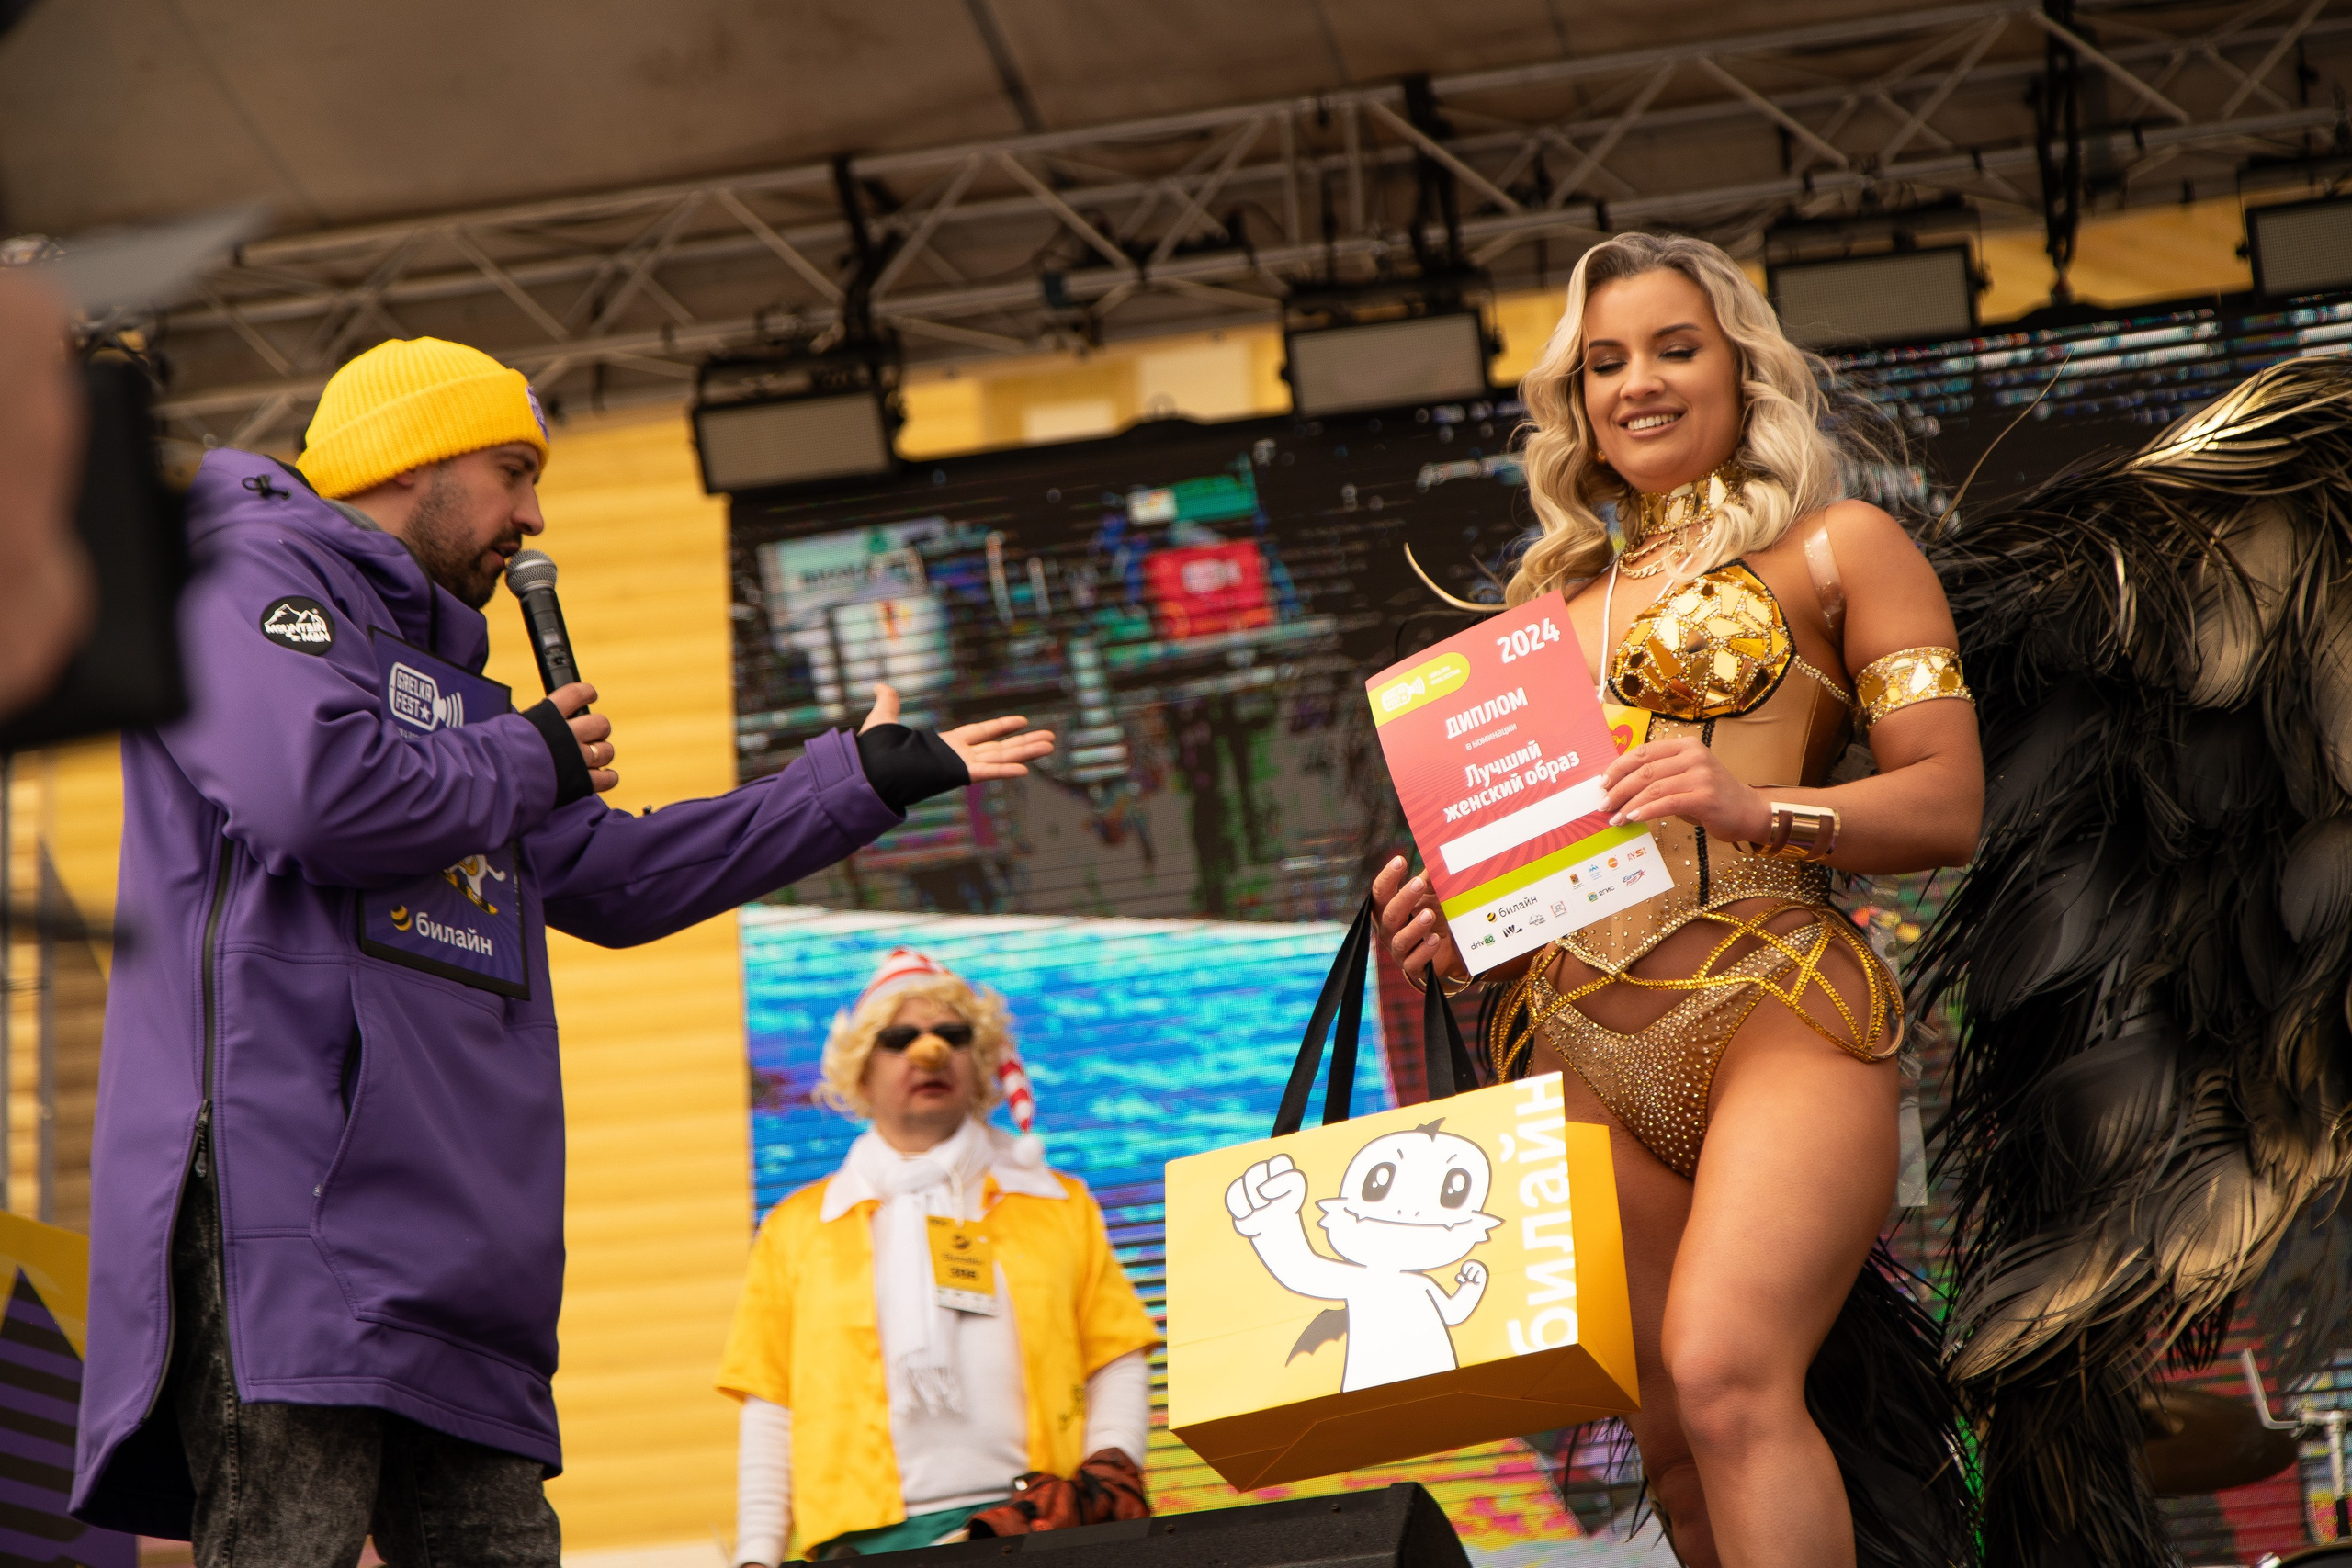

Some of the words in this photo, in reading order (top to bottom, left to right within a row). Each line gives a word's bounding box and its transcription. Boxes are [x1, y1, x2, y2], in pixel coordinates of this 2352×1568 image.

[1497, 617, 1561, 664] 2024
[395, 691, 421, 717] FEST
[1445, 687, 1528, 739] ДИПЛОМ
[1465, 742, 1473, 751] в
[1472, 723, 1518, 749] номинации
[1443, 773, 1525, 823] женский
[1525, 750, 1580, 784] образ
[1464, 740, 1543, 788] Лучший
[1498, 896, 1538, 918] билайн
[415, 911, 493, 956] билайн
[1498, 1071, 1578, 1356] билайн
